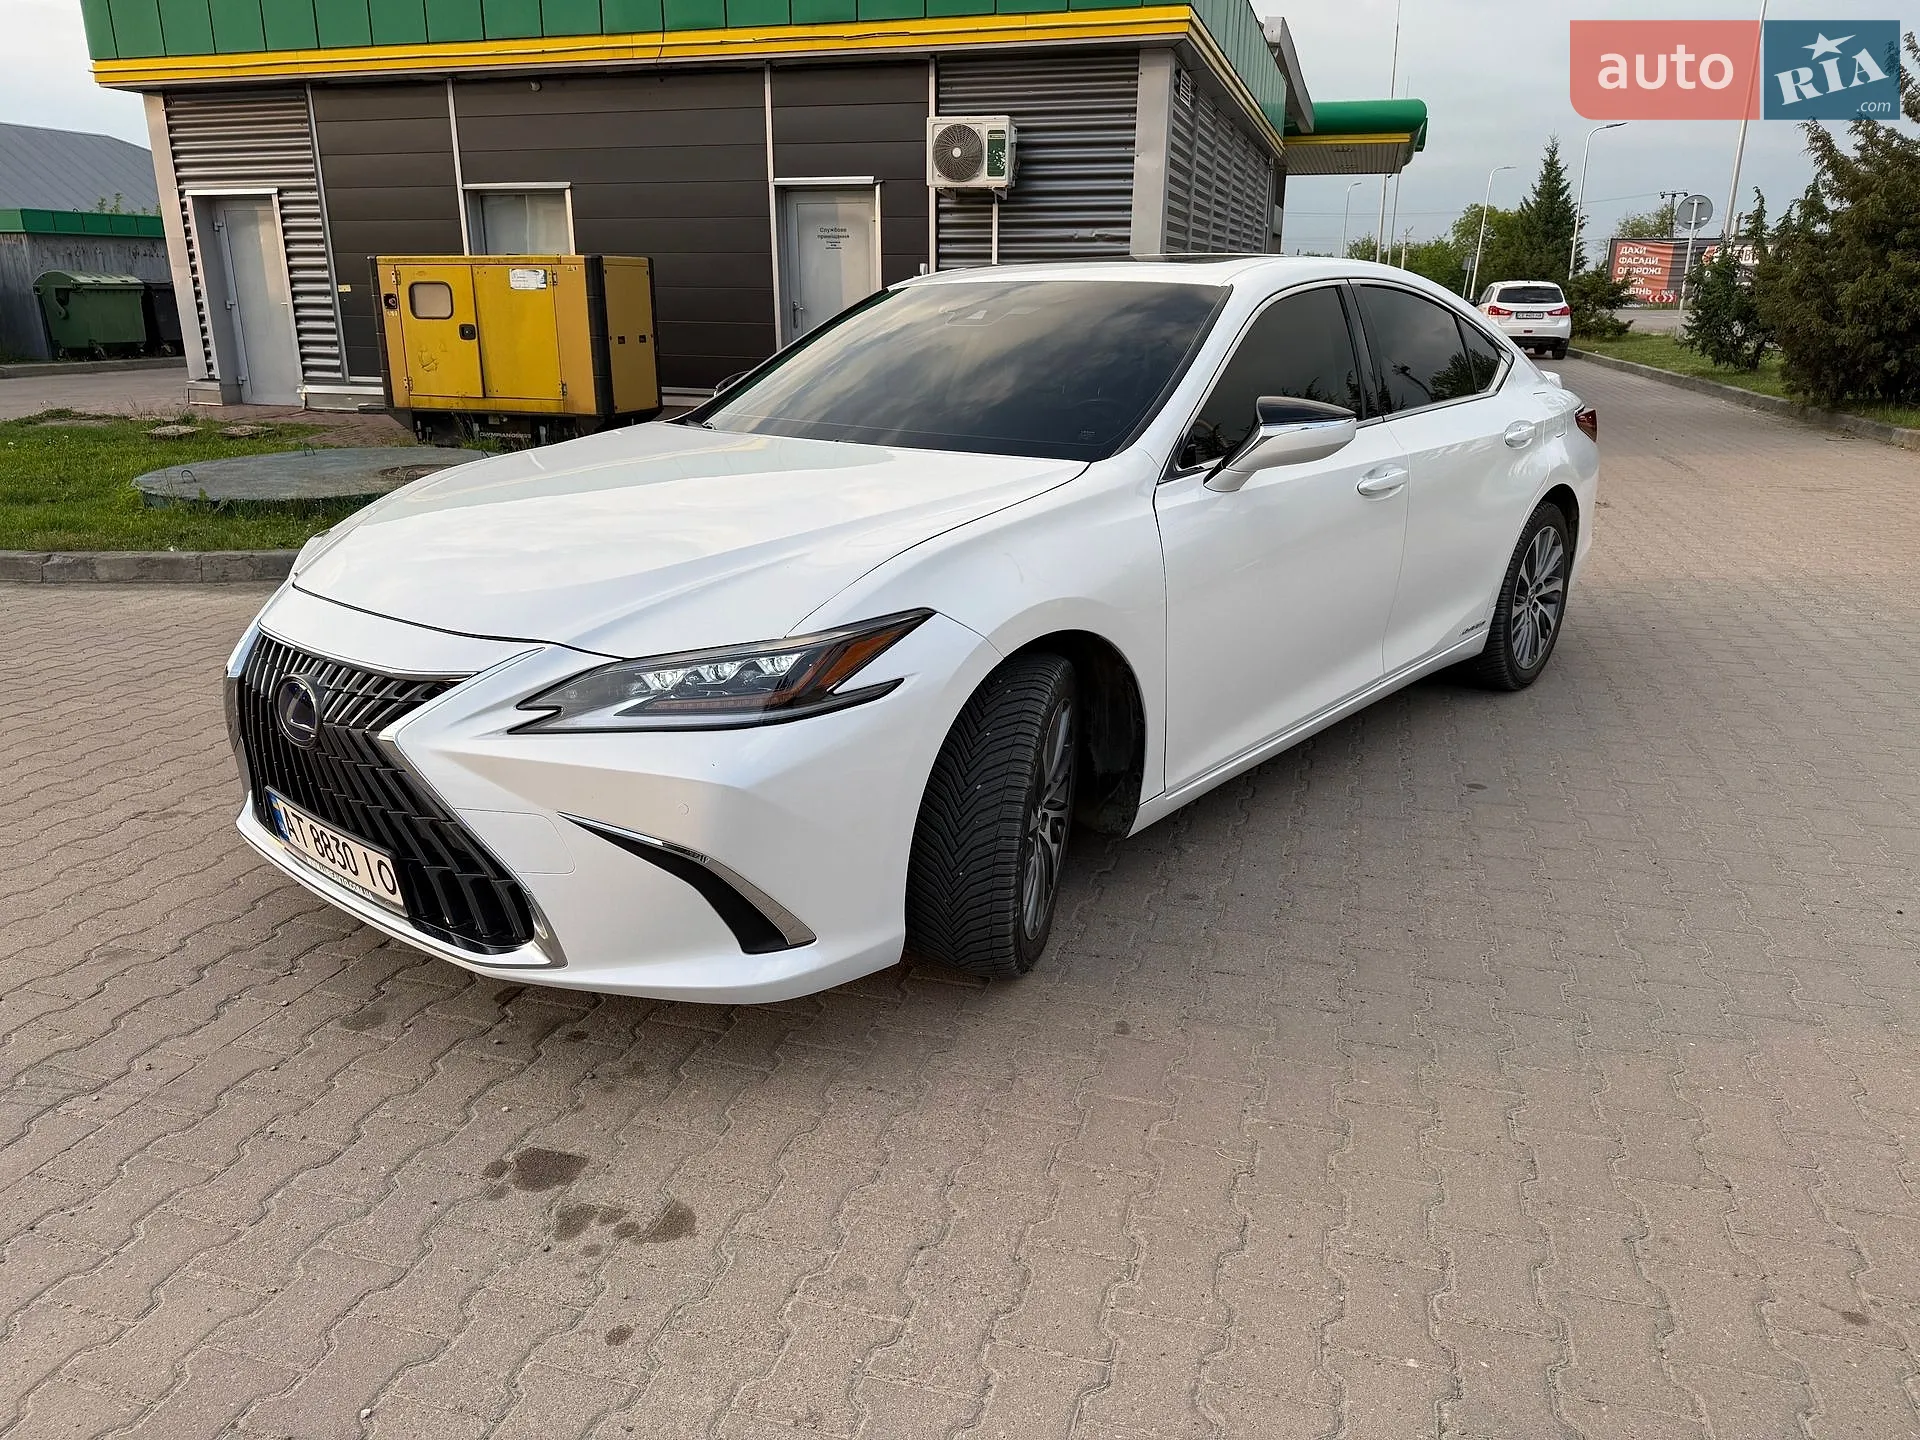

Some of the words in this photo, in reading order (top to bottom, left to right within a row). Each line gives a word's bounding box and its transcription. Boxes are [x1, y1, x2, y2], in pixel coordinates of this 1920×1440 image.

[1620, 246, 1647, 255] ДАХИ
[1618, 256, 1659, 265] ФАСАДИ
[282, 806, 309, 848] AT
[309, 823, 359, 876] 8830
[363, 851, 397, 896] IO
